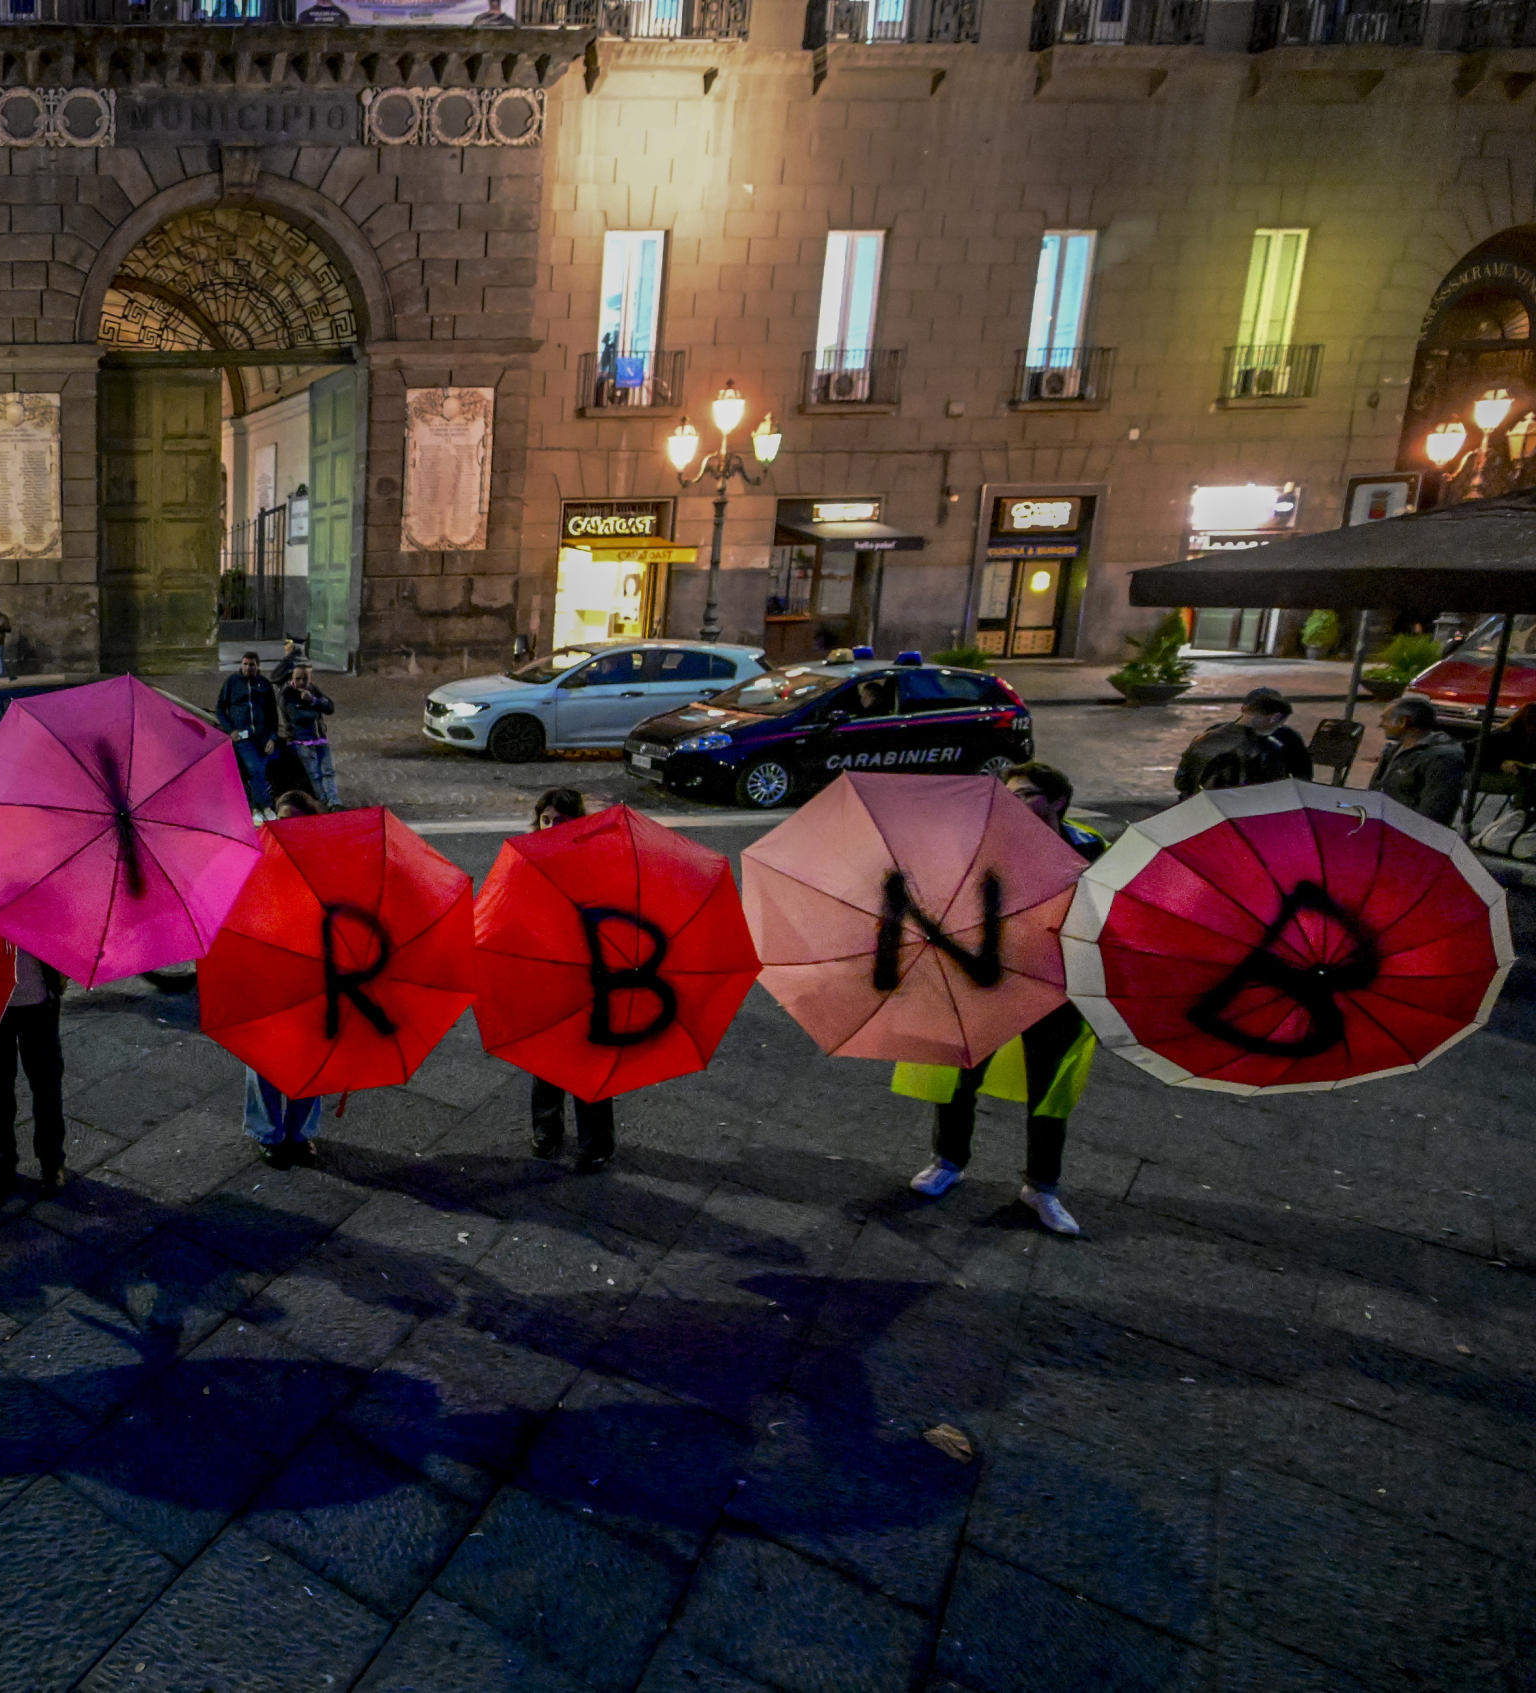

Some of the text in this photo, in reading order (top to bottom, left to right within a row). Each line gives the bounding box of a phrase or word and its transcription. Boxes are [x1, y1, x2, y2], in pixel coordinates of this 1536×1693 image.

[129, 104, 346, 131] MUNICIPIO
[568, 515, 657, 536] CAPATOAST
[617, 550, 673, 561] CAPATOAST
[1012, 717, 1030, 730] 112
[826, 747, 963, 770] CARABINIERI
[320, 902, 398, 1041] R
[579, 904, 677, 1046] B
[873, 870, 1003, 991] N
[1189, 880, 1380, 1058] B
